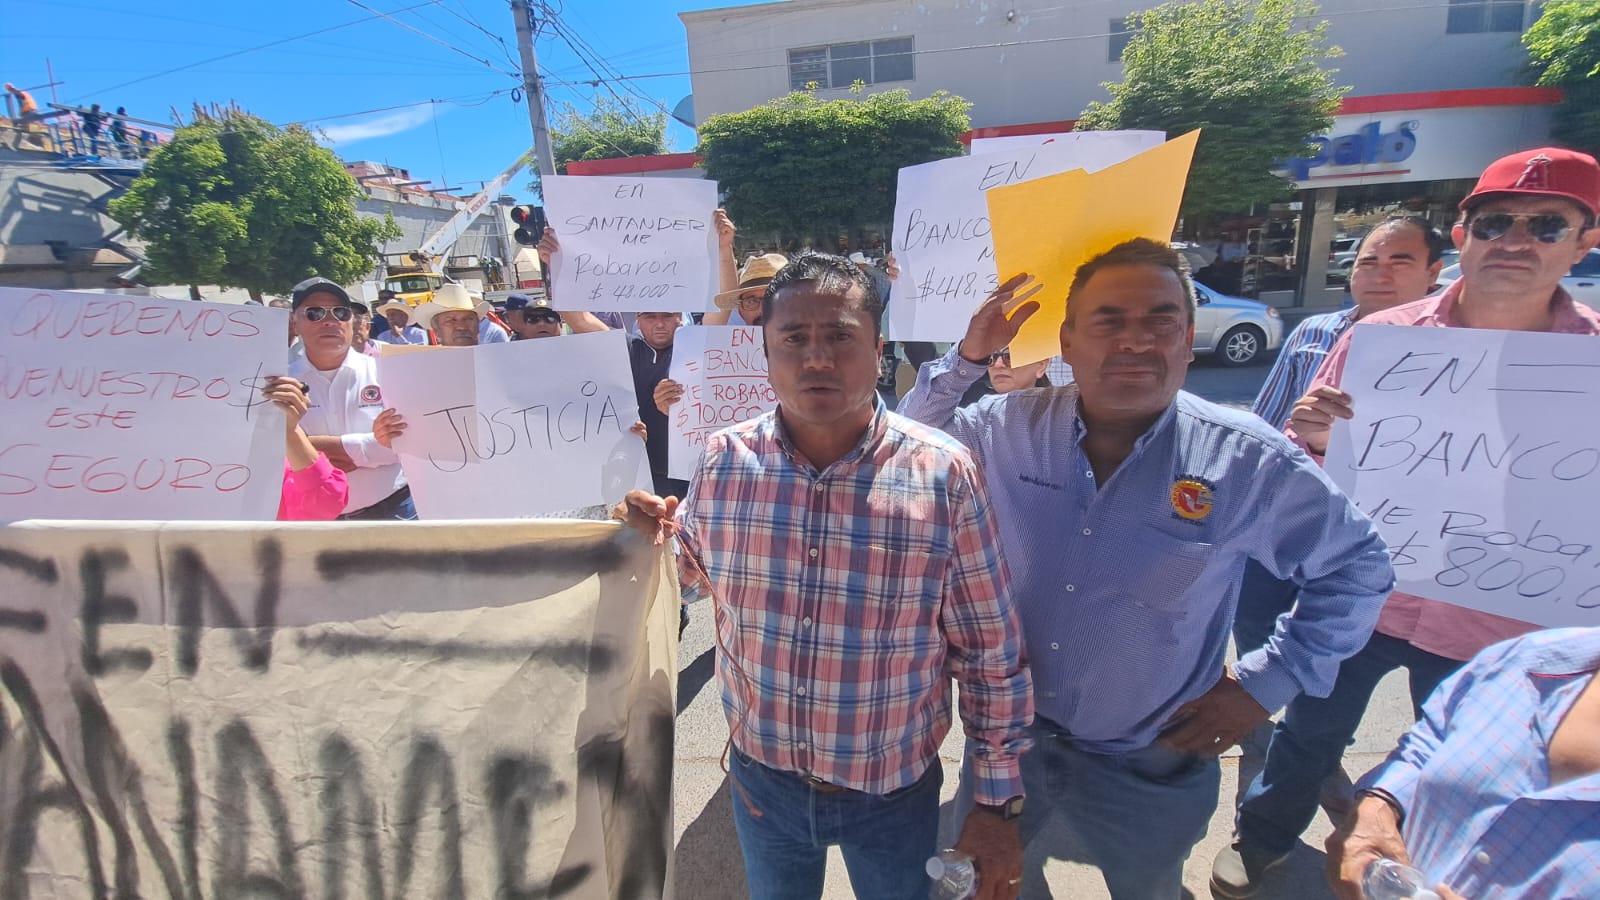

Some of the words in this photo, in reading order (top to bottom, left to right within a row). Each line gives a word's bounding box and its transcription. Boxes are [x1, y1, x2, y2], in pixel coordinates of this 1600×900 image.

[977, 153, 1037, 191] EN
[558, 214, 706, 236] SANTANDER
[622, 233, 652, 246] ME
[900, 208, 992, 252] BANCO
[10, 292, 261, 341] QUEREMOS
[731, 328, 756, 347] EN
[711, 383, 779, 405] ROBARO
[1373, 349, 1488, 397] EN
[0, 443, 251, 495] SEGURO
[1349, 414, 1600, 481] BANCO
[1440, 511, 1600, 567] Roba
[80, 536, 283, 679] EN
